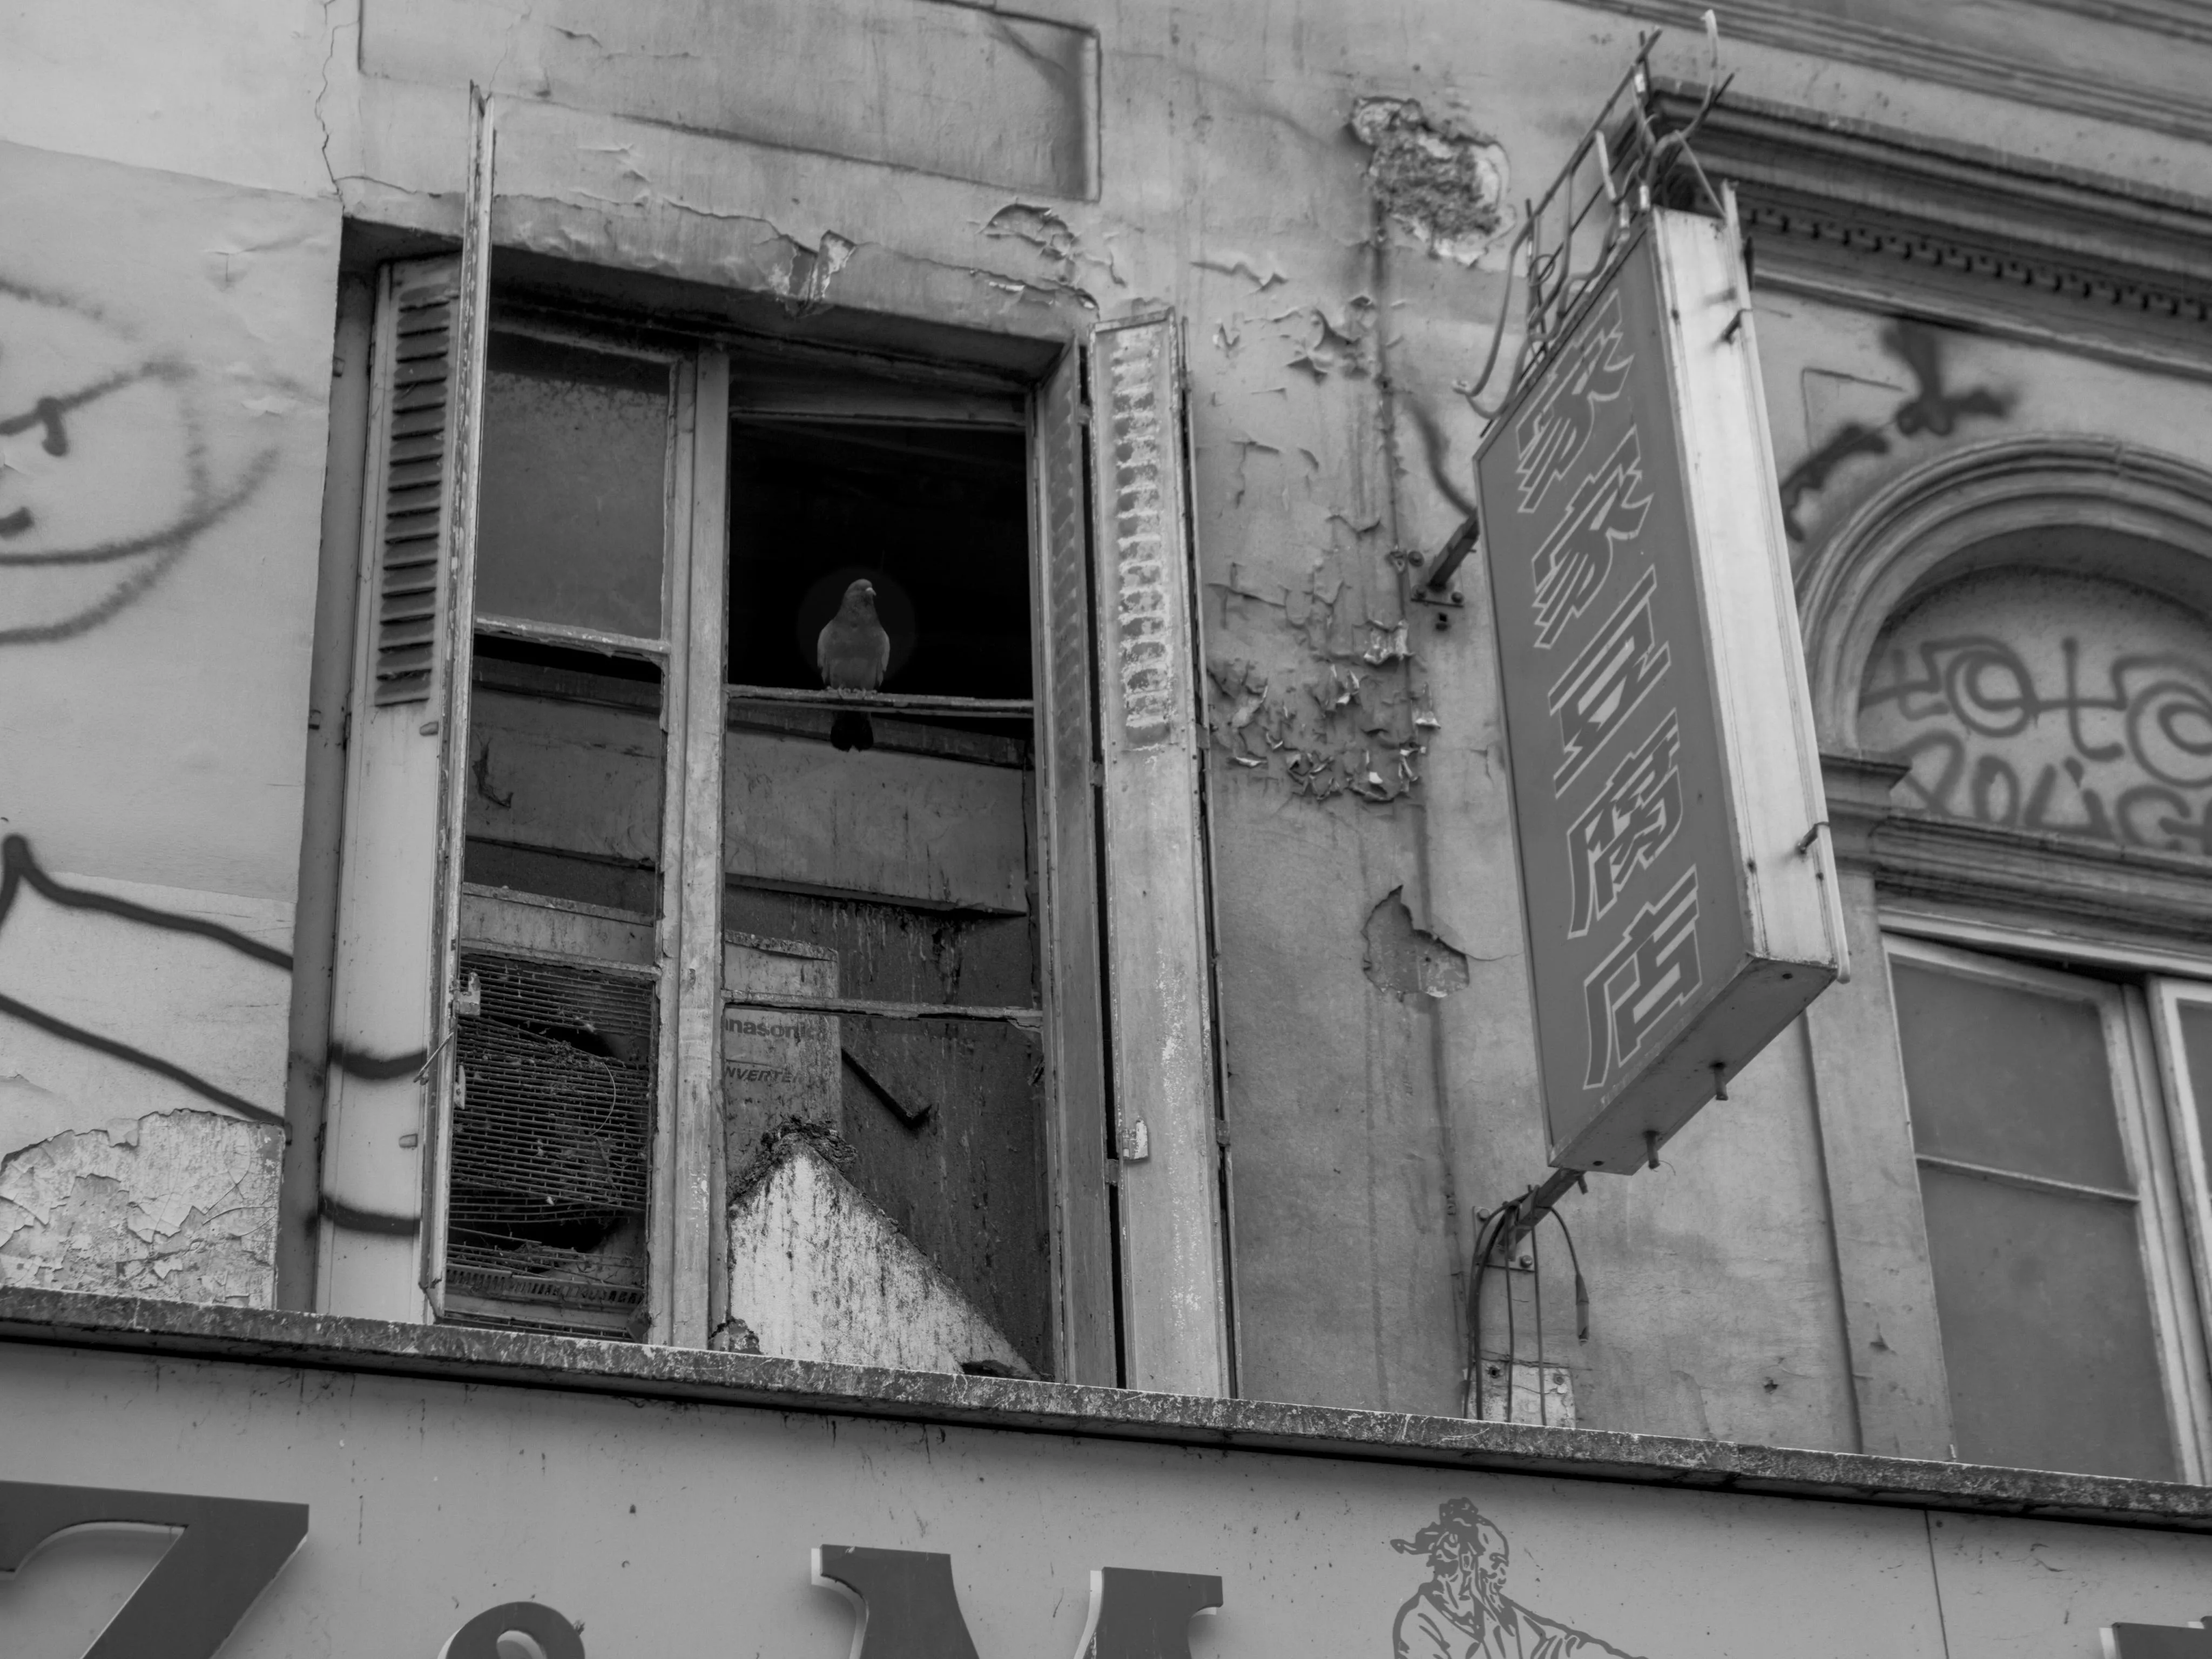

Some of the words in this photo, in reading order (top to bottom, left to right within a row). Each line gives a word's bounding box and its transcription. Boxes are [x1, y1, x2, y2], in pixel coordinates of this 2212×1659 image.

[1518, 289, 1702, 1090] 家家豆腐店
